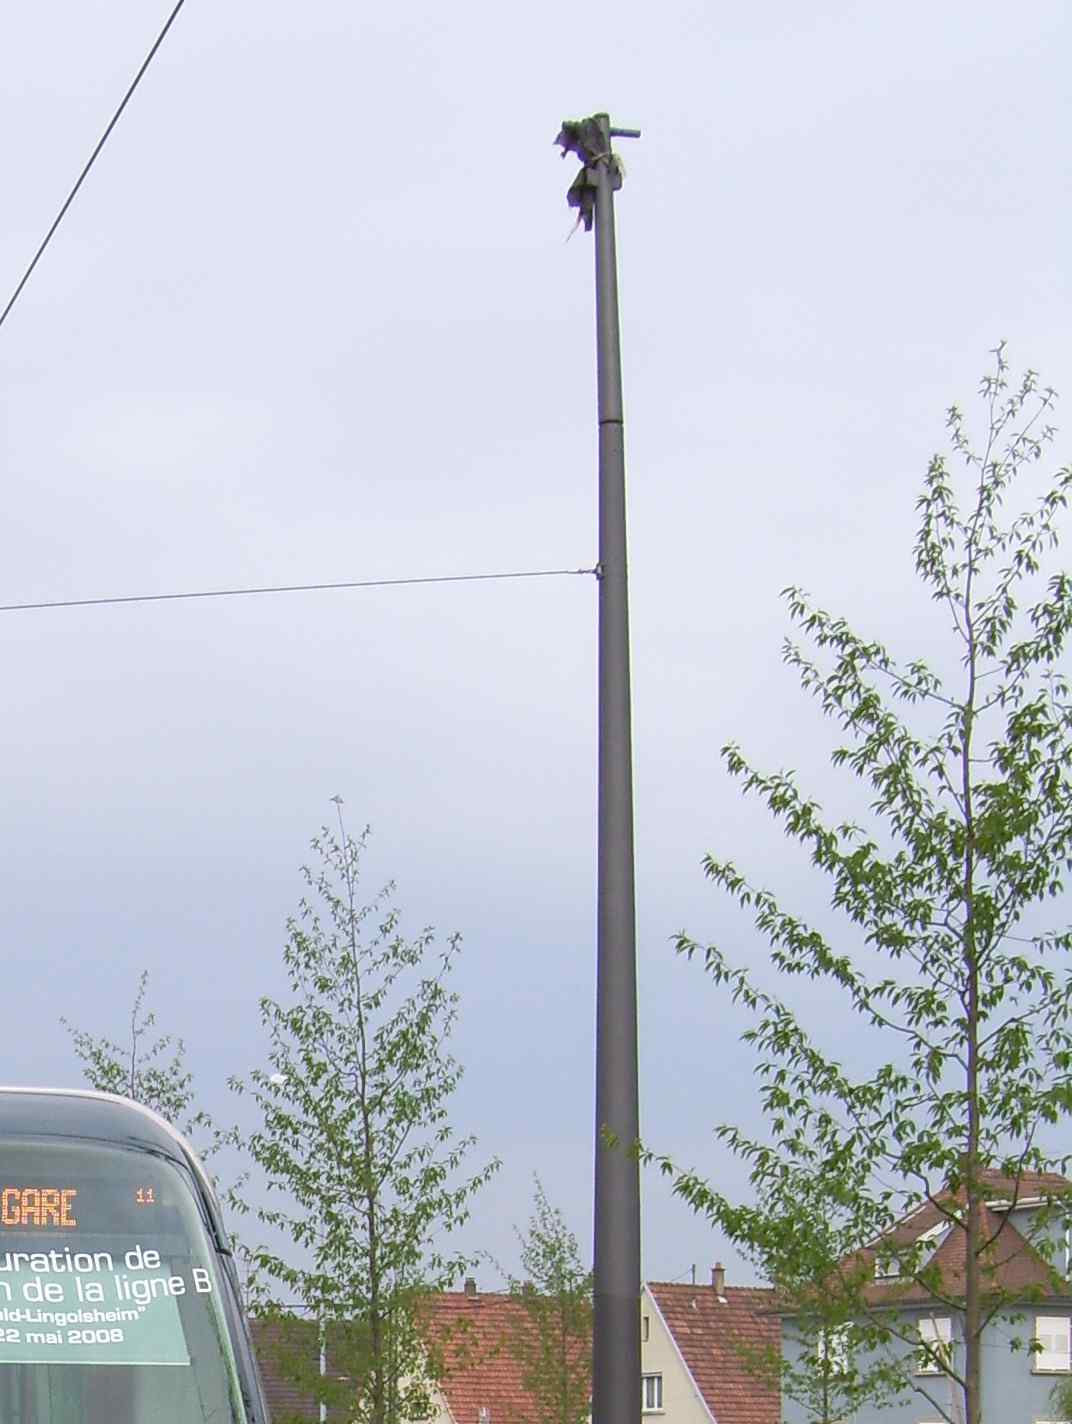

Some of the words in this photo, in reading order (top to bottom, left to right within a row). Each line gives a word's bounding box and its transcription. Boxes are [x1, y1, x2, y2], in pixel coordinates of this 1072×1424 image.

[0, 1188, 77, 1226] GARE
[125, 1244, 161, 1270] de
[22, 1276, 64, 1302] de
[75, 1276, 104, 1302] la
[114, 1274, 186, 1305] ligne
[192, 1268, 212, 1293] B
[27, 1330, 63, 1344] mai
[68, 1328, 124, 1344] 2008
